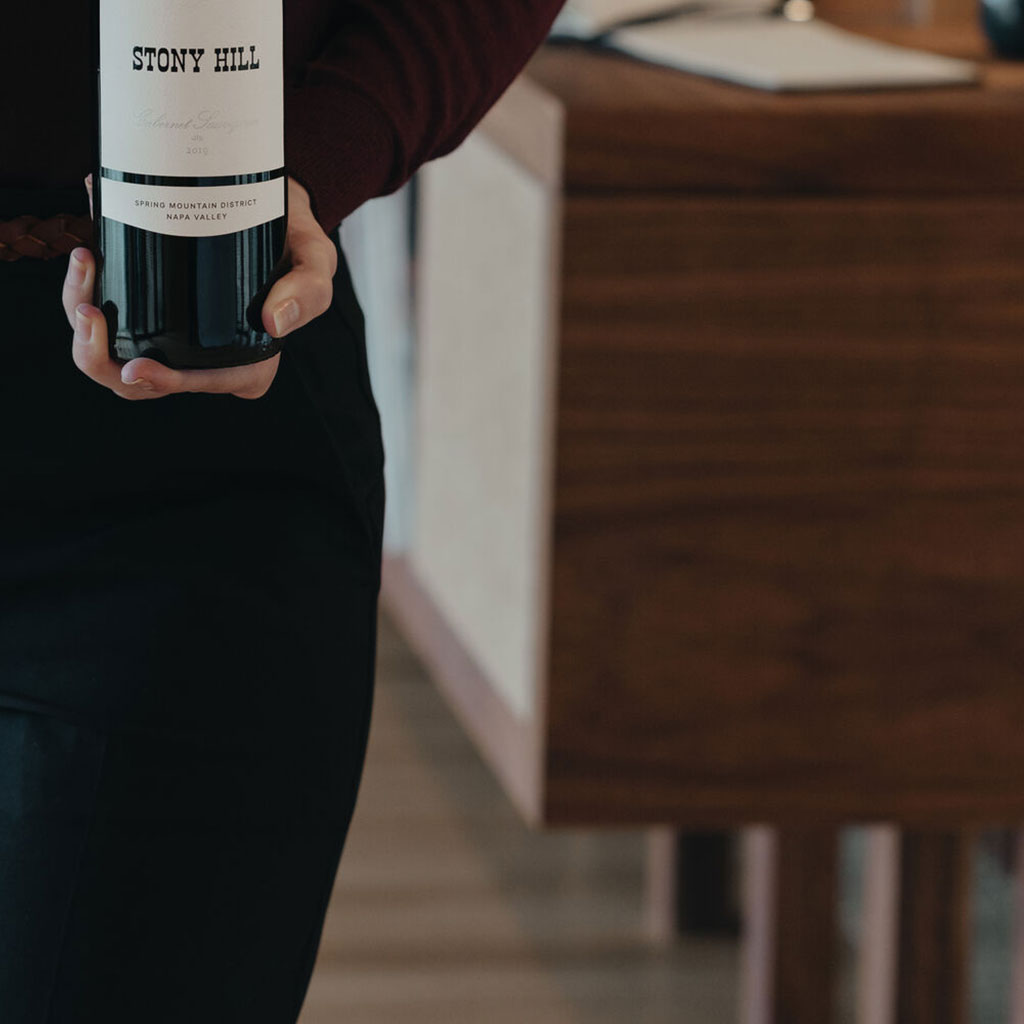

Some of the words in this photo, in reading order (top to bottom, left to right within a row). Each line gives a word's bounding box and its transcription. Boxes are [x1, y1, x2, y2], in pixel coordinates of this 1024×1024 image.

[132, 45, 205, 73] STONY
[214, 45, 260, 73] HILL
[134, 199, 166, 209] SPRING
[169, 202, 218, 210] MOUNTAIN
[220, 198, 258, 209] DISTRICT
[166, 213, 191, 221] NAPA
[194, 212, 228, 221] VALLEY
